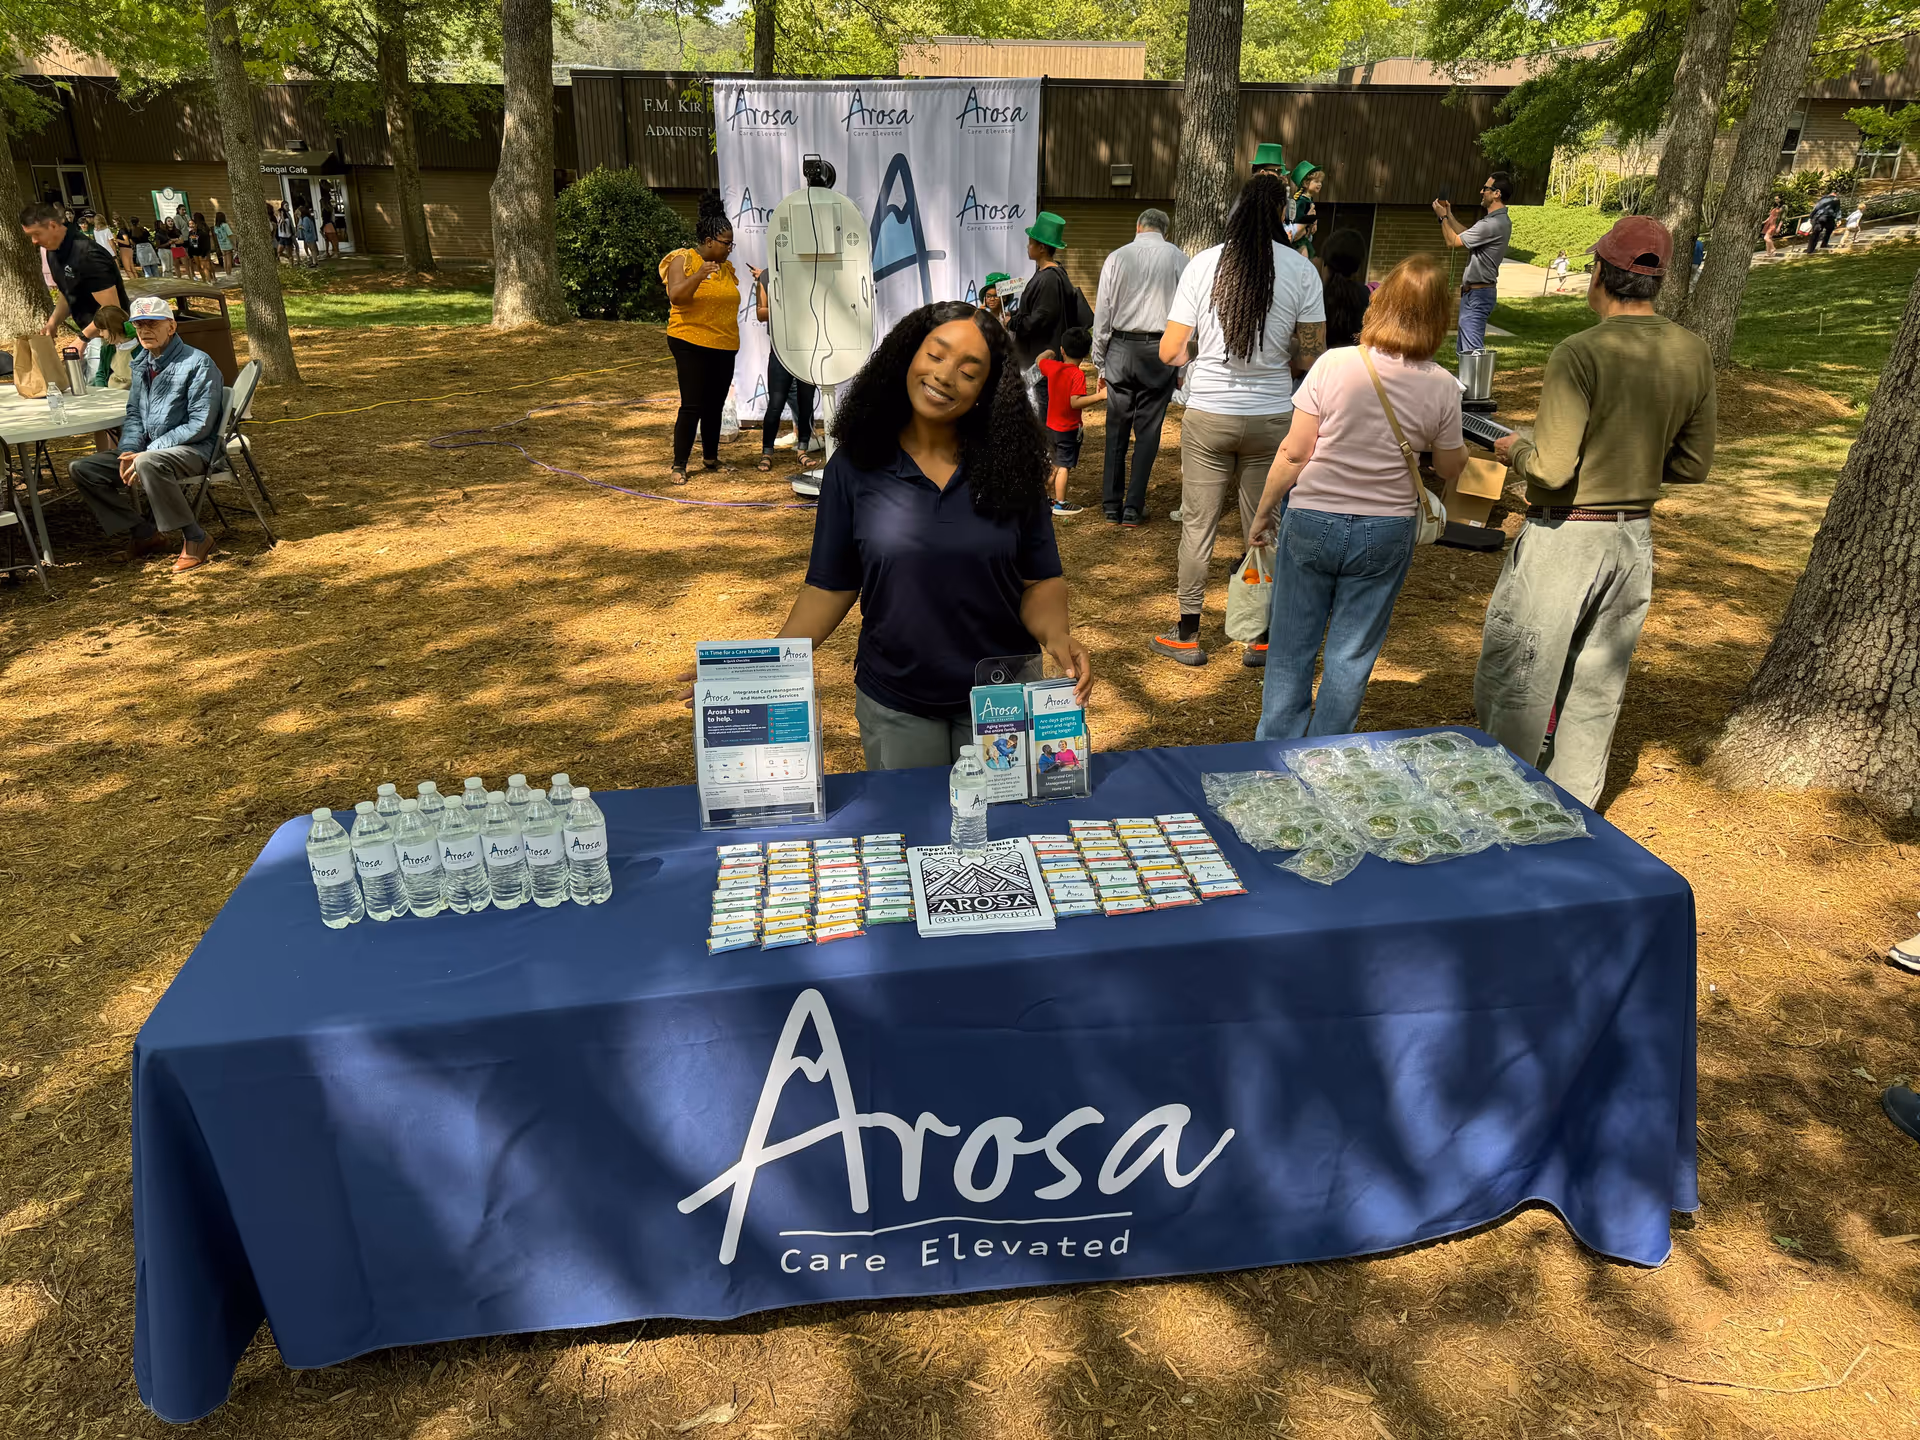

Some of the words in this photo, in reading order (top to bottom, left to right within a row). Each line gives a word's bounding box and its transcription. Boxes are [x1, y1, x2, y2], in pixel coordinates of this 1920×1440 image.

[643, 98, 672, 112] F.M.
[678, 99, 702, 112] KIR
[726, 88, 798, 131] Arosa
[841, 88, 914, 132] Arosa
[956, 86, 1028, 129] Arosa
[645, 124, 710, 137] ADMINIST
[732, 186, 774, 228] Aro
[956, 185, 1026, 227] Arosa
[782, 647, 808, 661] Arosa
[702, 690, 731, 704] Arosa
[1044, 694, 1071, 709] Arosa
[979, 697, 1022, 720] Arosa
[489, 842, 519, 858] Arosa
[525, 841, 552, 856] Arosa
[571, 837, 601, 852] Arosa
[355, 853, 383, 868] Arosa
[401, 851, 432, 865] Arosa
[444, 847, 475, 861] Arosa
[311, 862, 340, 876] Arosa
[938, 895, 1032, 912] AROSA
[935, 916, 970, 924] Care
[972, 910, 1035, 921] Elevated
[677, 988, 1235, 1264] Arosa
[780, 1248, 886, 1274] Care
[921, 1230, 1130, 1266] Elevated
